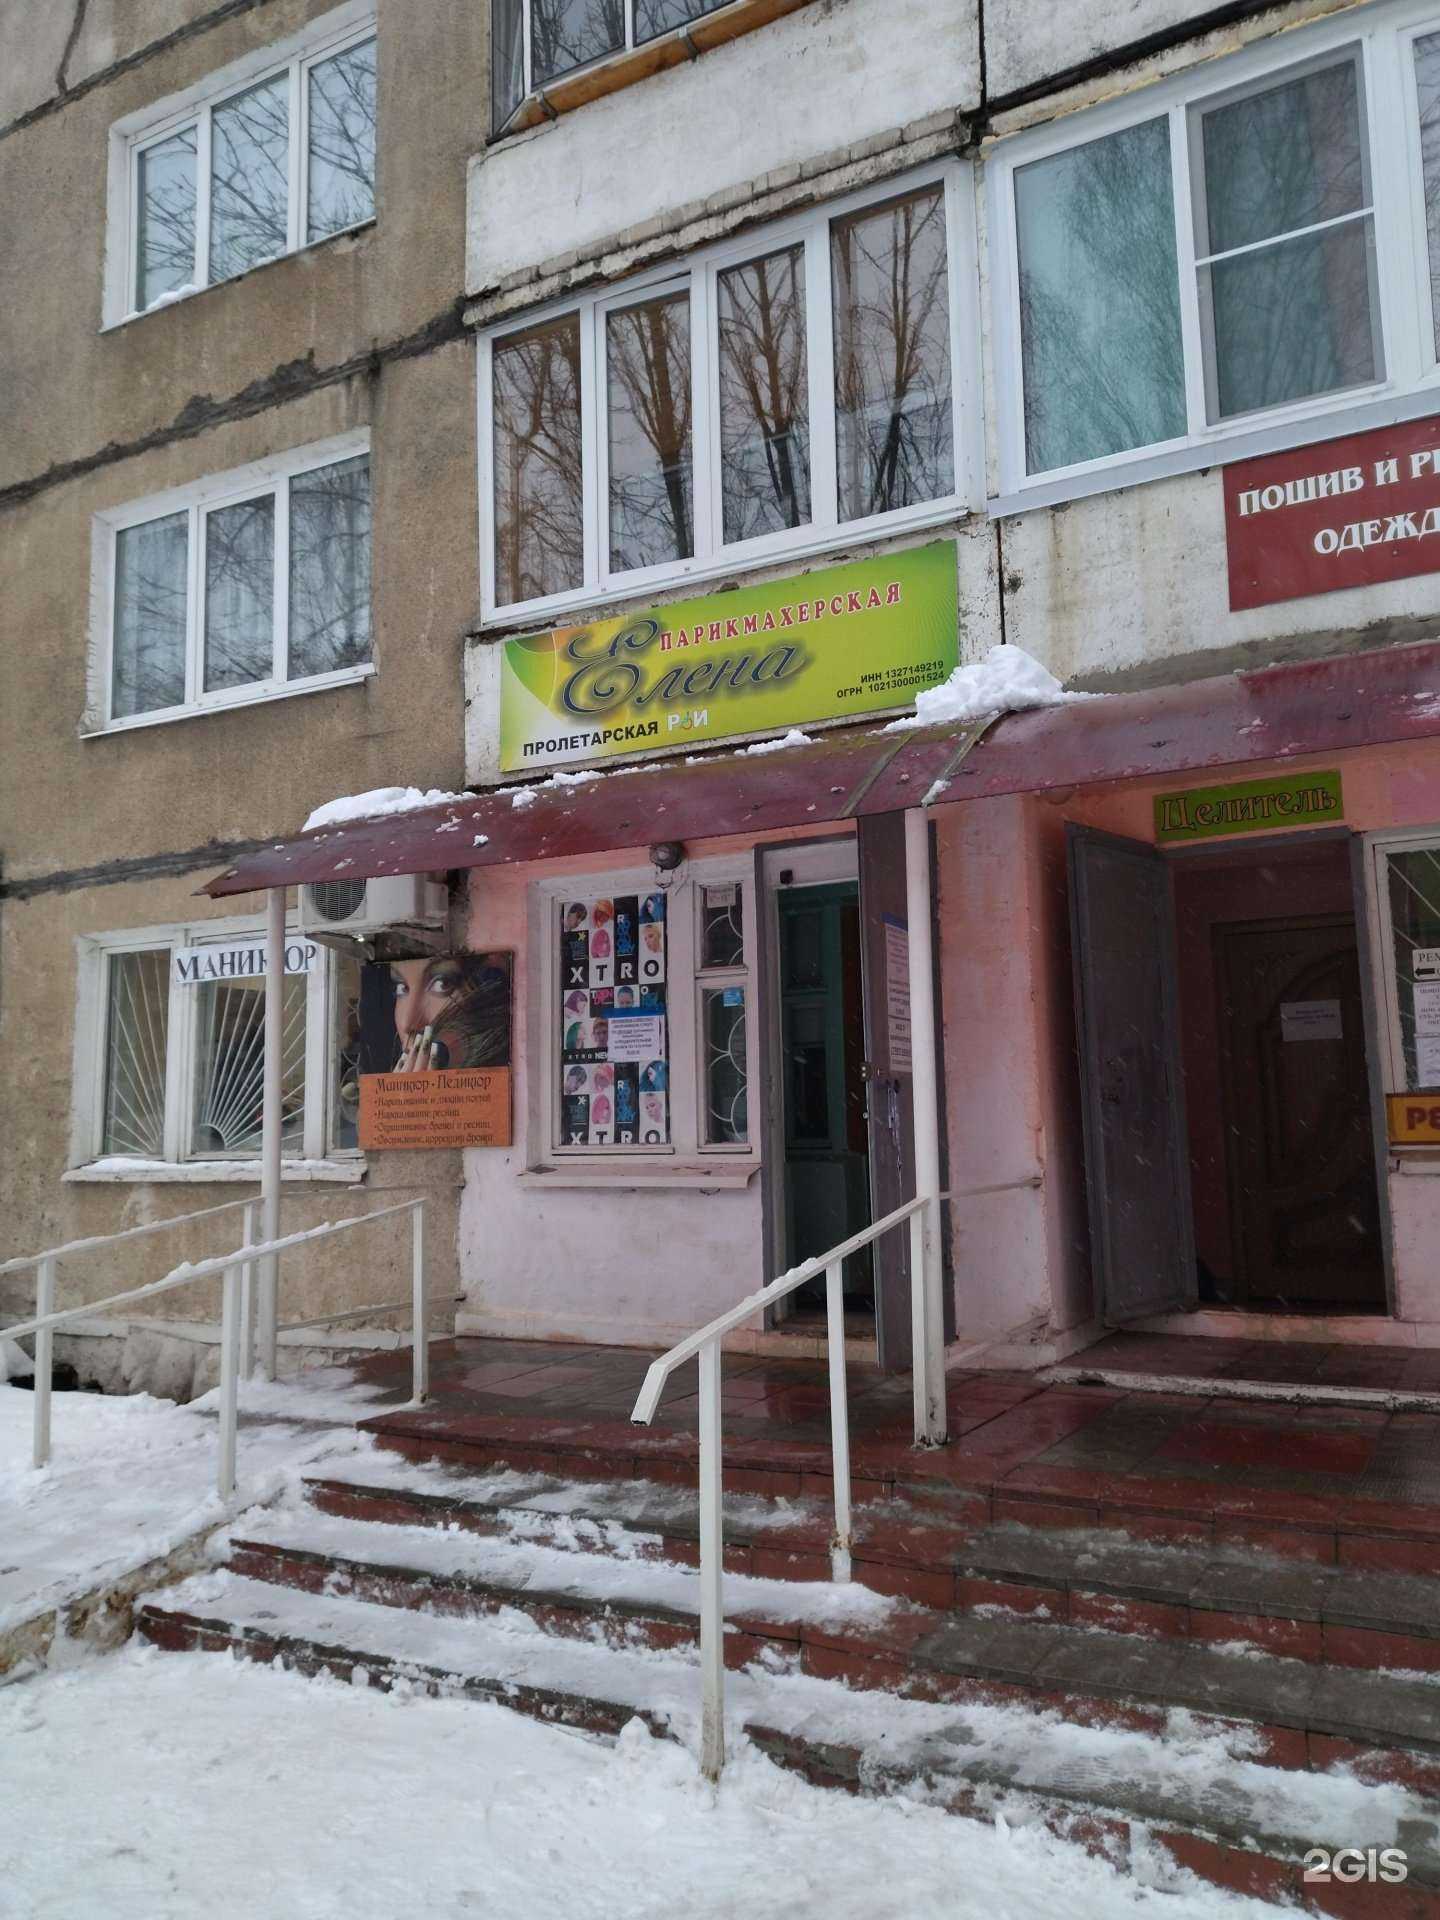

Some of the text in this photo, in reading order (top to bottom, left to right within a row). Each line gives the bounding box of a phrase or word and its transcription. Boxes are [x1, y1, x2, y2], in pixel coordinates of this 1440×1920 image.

[1238, 467, 1365, 517] ПОШИВ
[1374, 458, 1399, 487] И
[660, 583, 901, 651] ПАРИКМАХЕРСКАЯ
[563, 618, 806, 714] Елена
[836, 671, 945, 698] ОГРН 1021300001524
[860, 660, 944, 684] ИНН 1327149219
[523, 721, 659, 757] ПРОЛЕТАРСКАЯ
[1161, 787, 1337, 832] Целитель
[375, 1074, 492, 1094] Маникюр Педикюр
